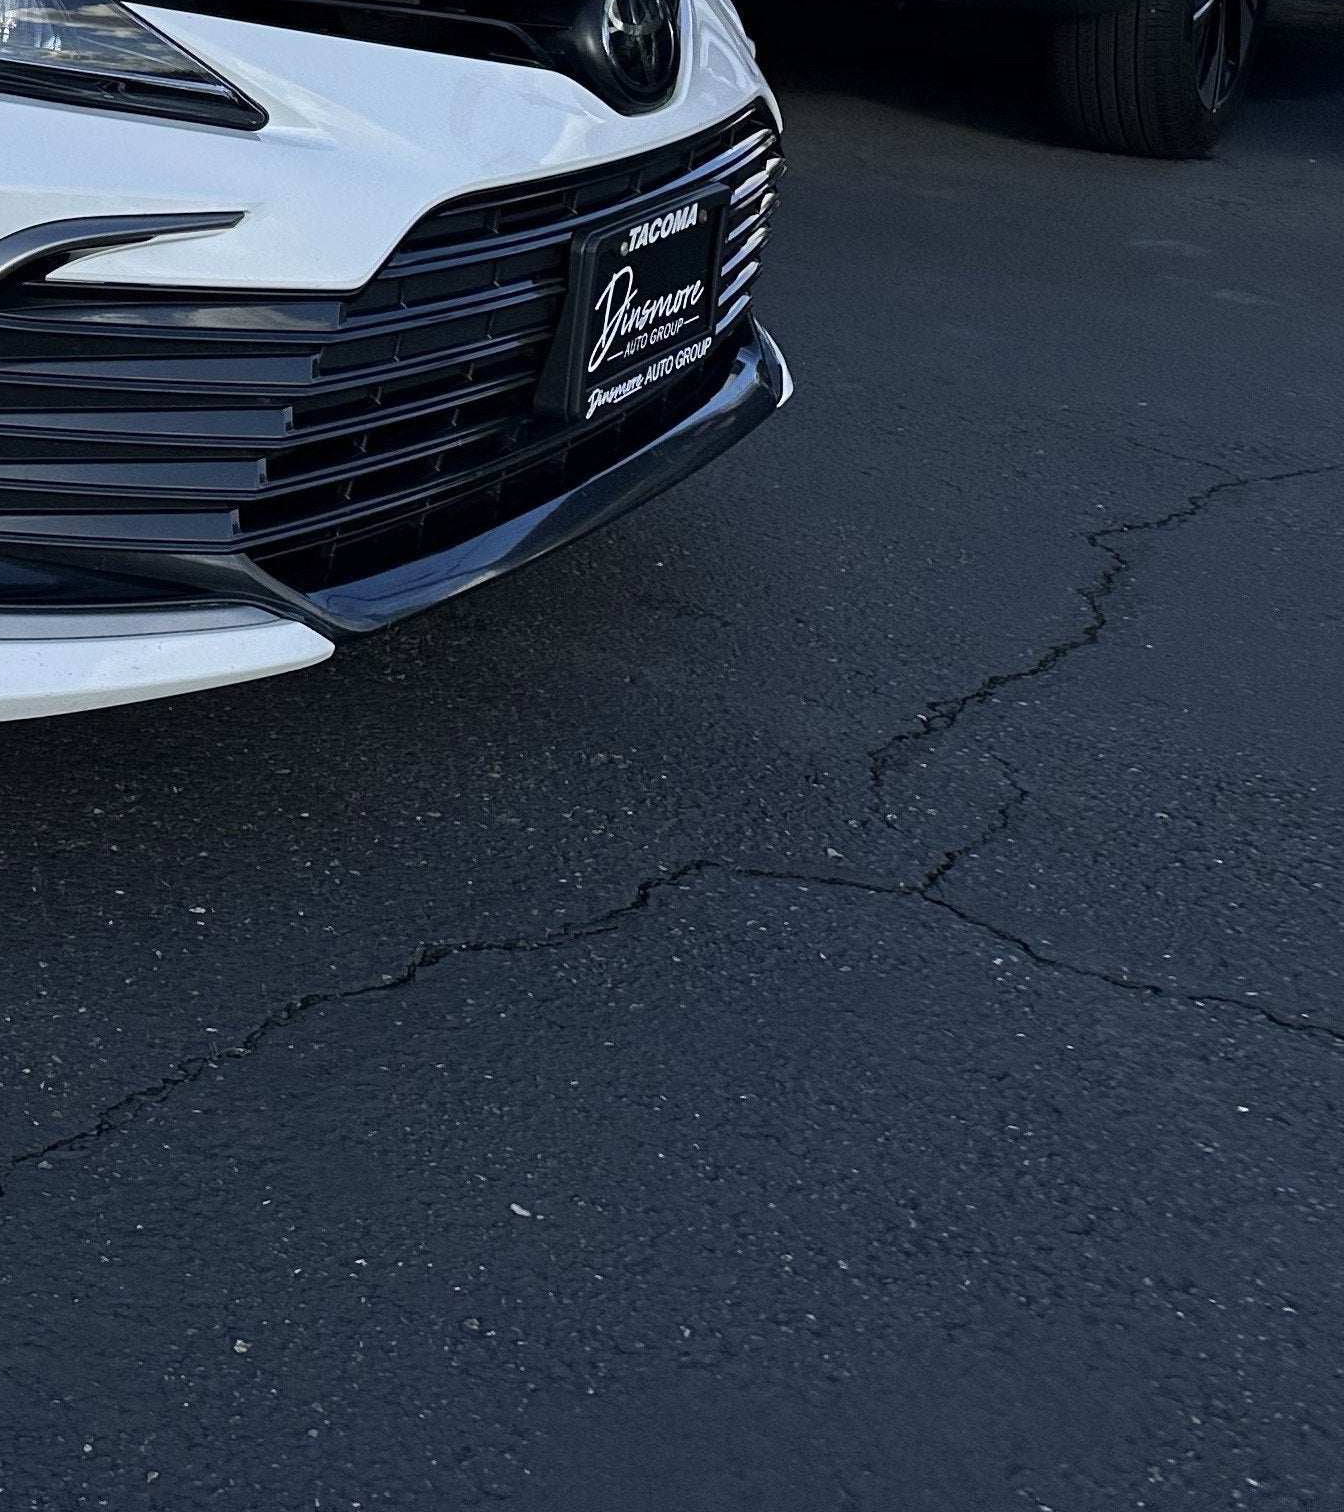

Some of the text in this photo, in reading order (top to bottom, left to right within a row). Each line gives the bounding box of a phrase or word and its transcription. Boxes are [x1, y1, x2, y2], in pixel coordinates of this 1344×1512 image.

[627, 202, 700, 252] TACOMA
[587, 265, 705, 373] Dinsmore
[623, 317, 685, 359] AUTO GROUP
[585, 336, 712, 420] Dinsmore AUTO GROUP
